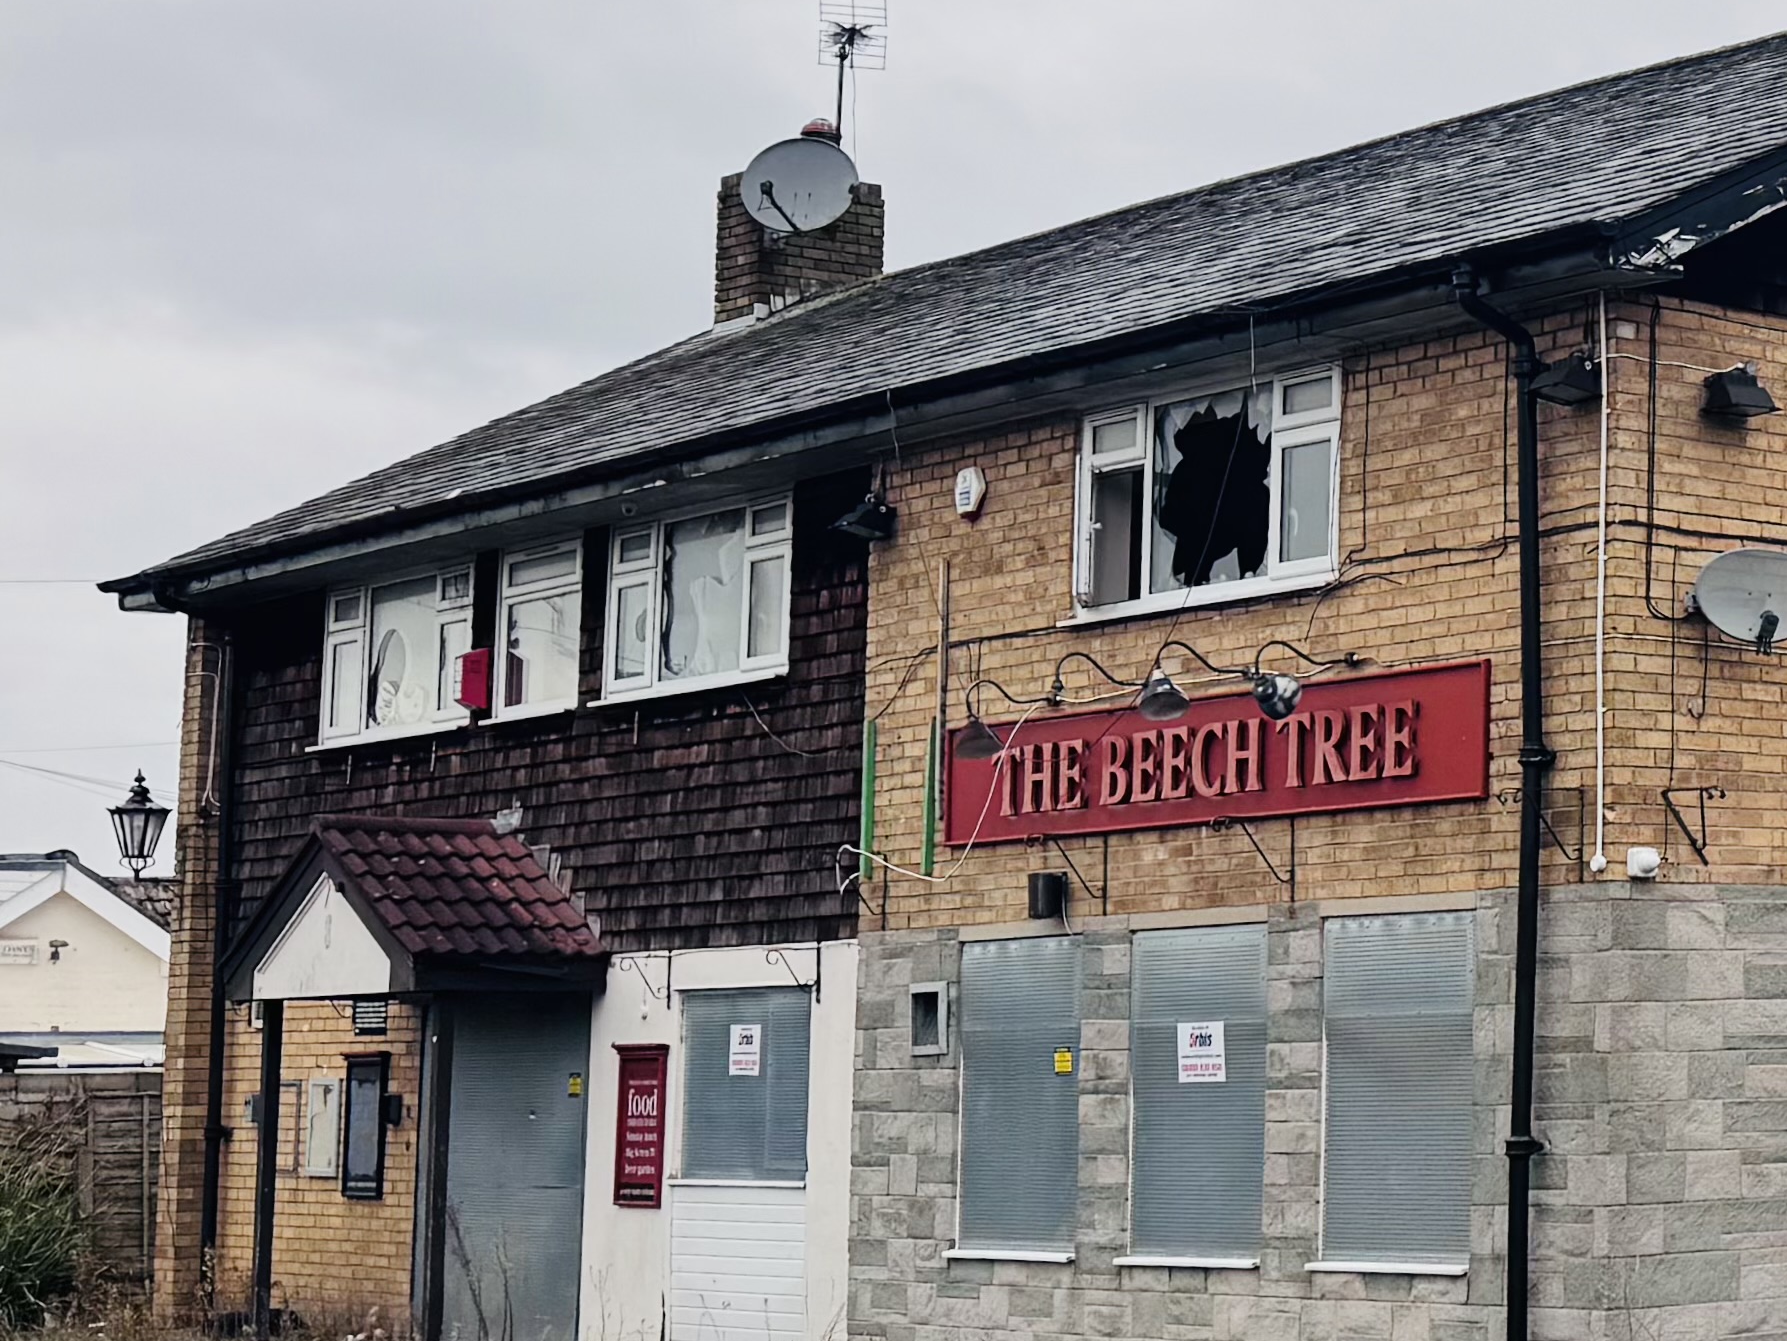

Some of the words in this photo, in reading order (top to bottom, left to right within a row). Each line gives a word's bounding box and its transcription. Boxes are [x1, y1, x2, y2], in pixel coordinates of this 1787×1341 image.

[992, 738, 1086, 817] THE
[1098, 717, 1267, 806] BEECH
[1275, 699, 1417, 788] TREE
[627, 1088, 658, 1117] food
